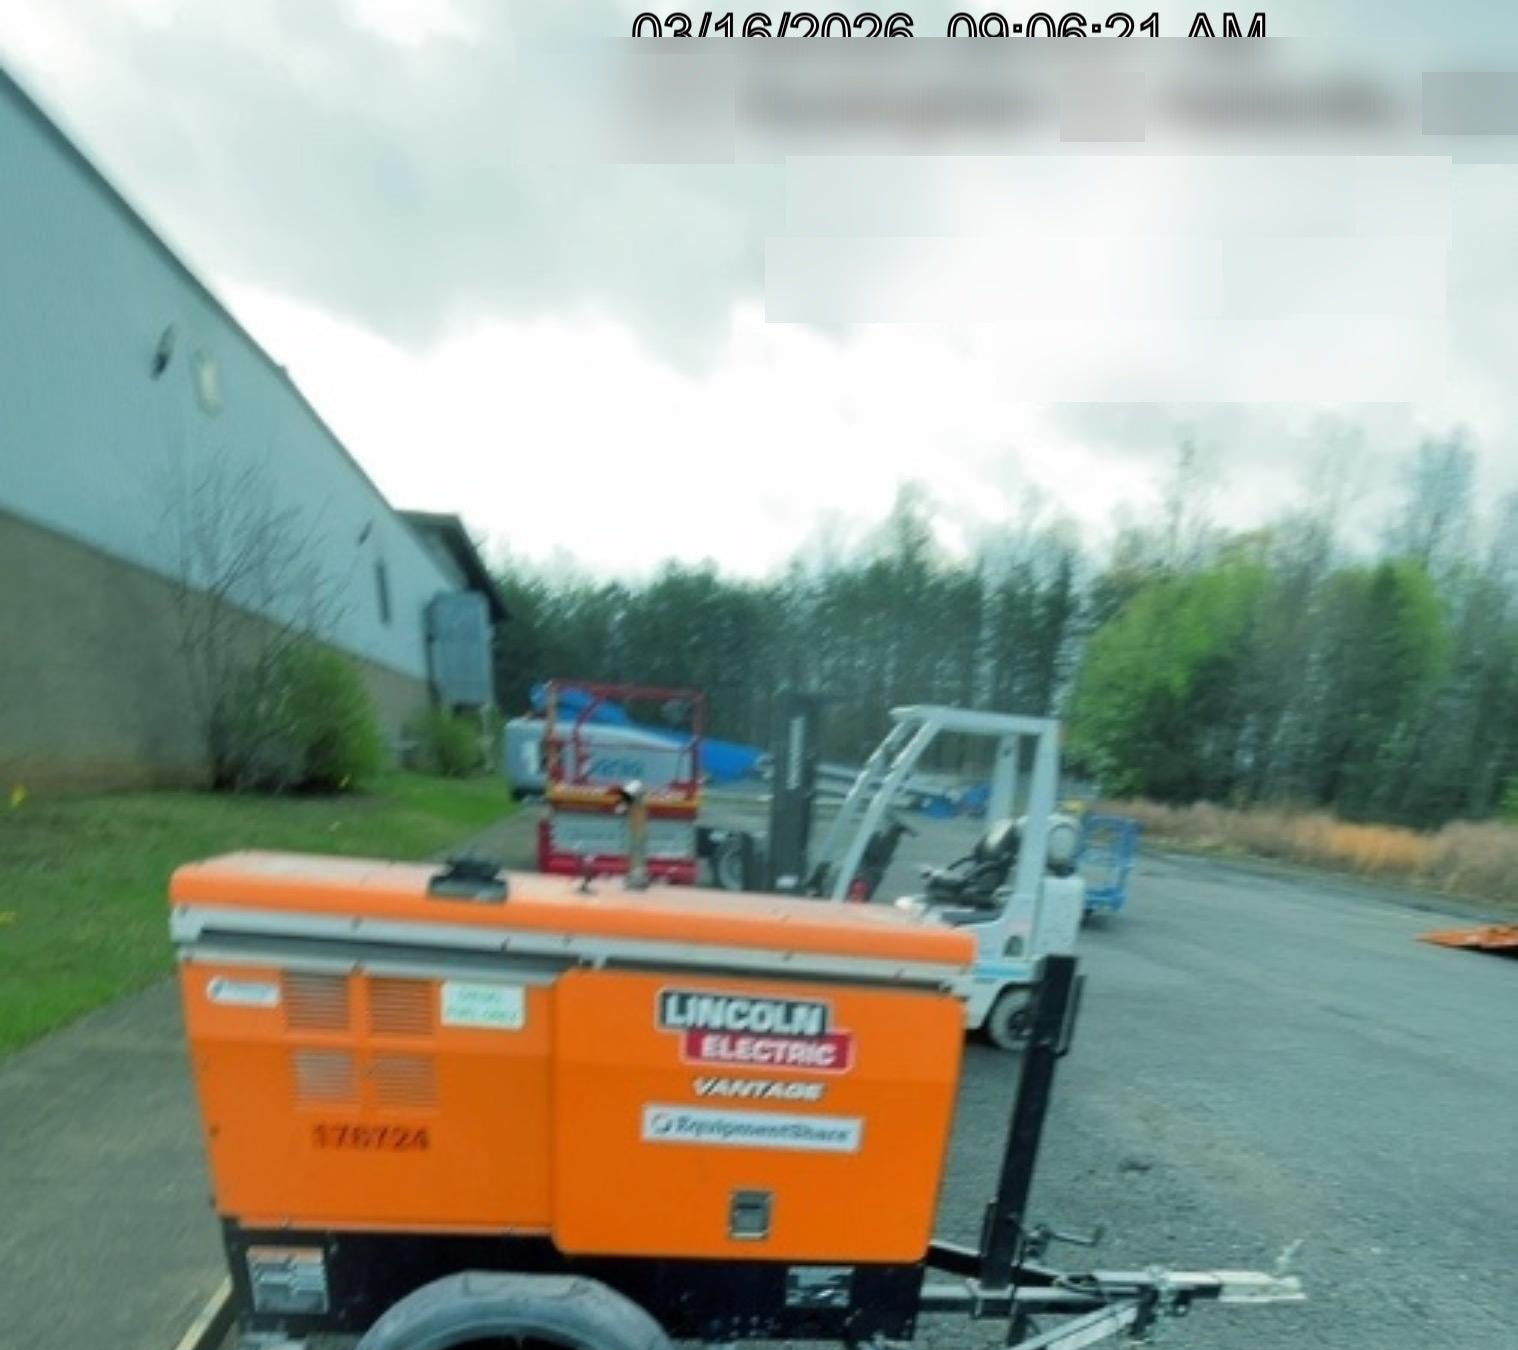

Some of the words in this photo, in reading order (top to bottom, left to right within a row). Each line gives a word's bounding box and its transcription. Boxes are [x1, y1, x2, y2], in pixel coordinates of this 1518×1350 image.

[665, 993, 824, 1035] LINCOLN
[701, 1034, 837, 1067] ELECTRIC
[693, 1077, 826, 1101] VANTAGE
